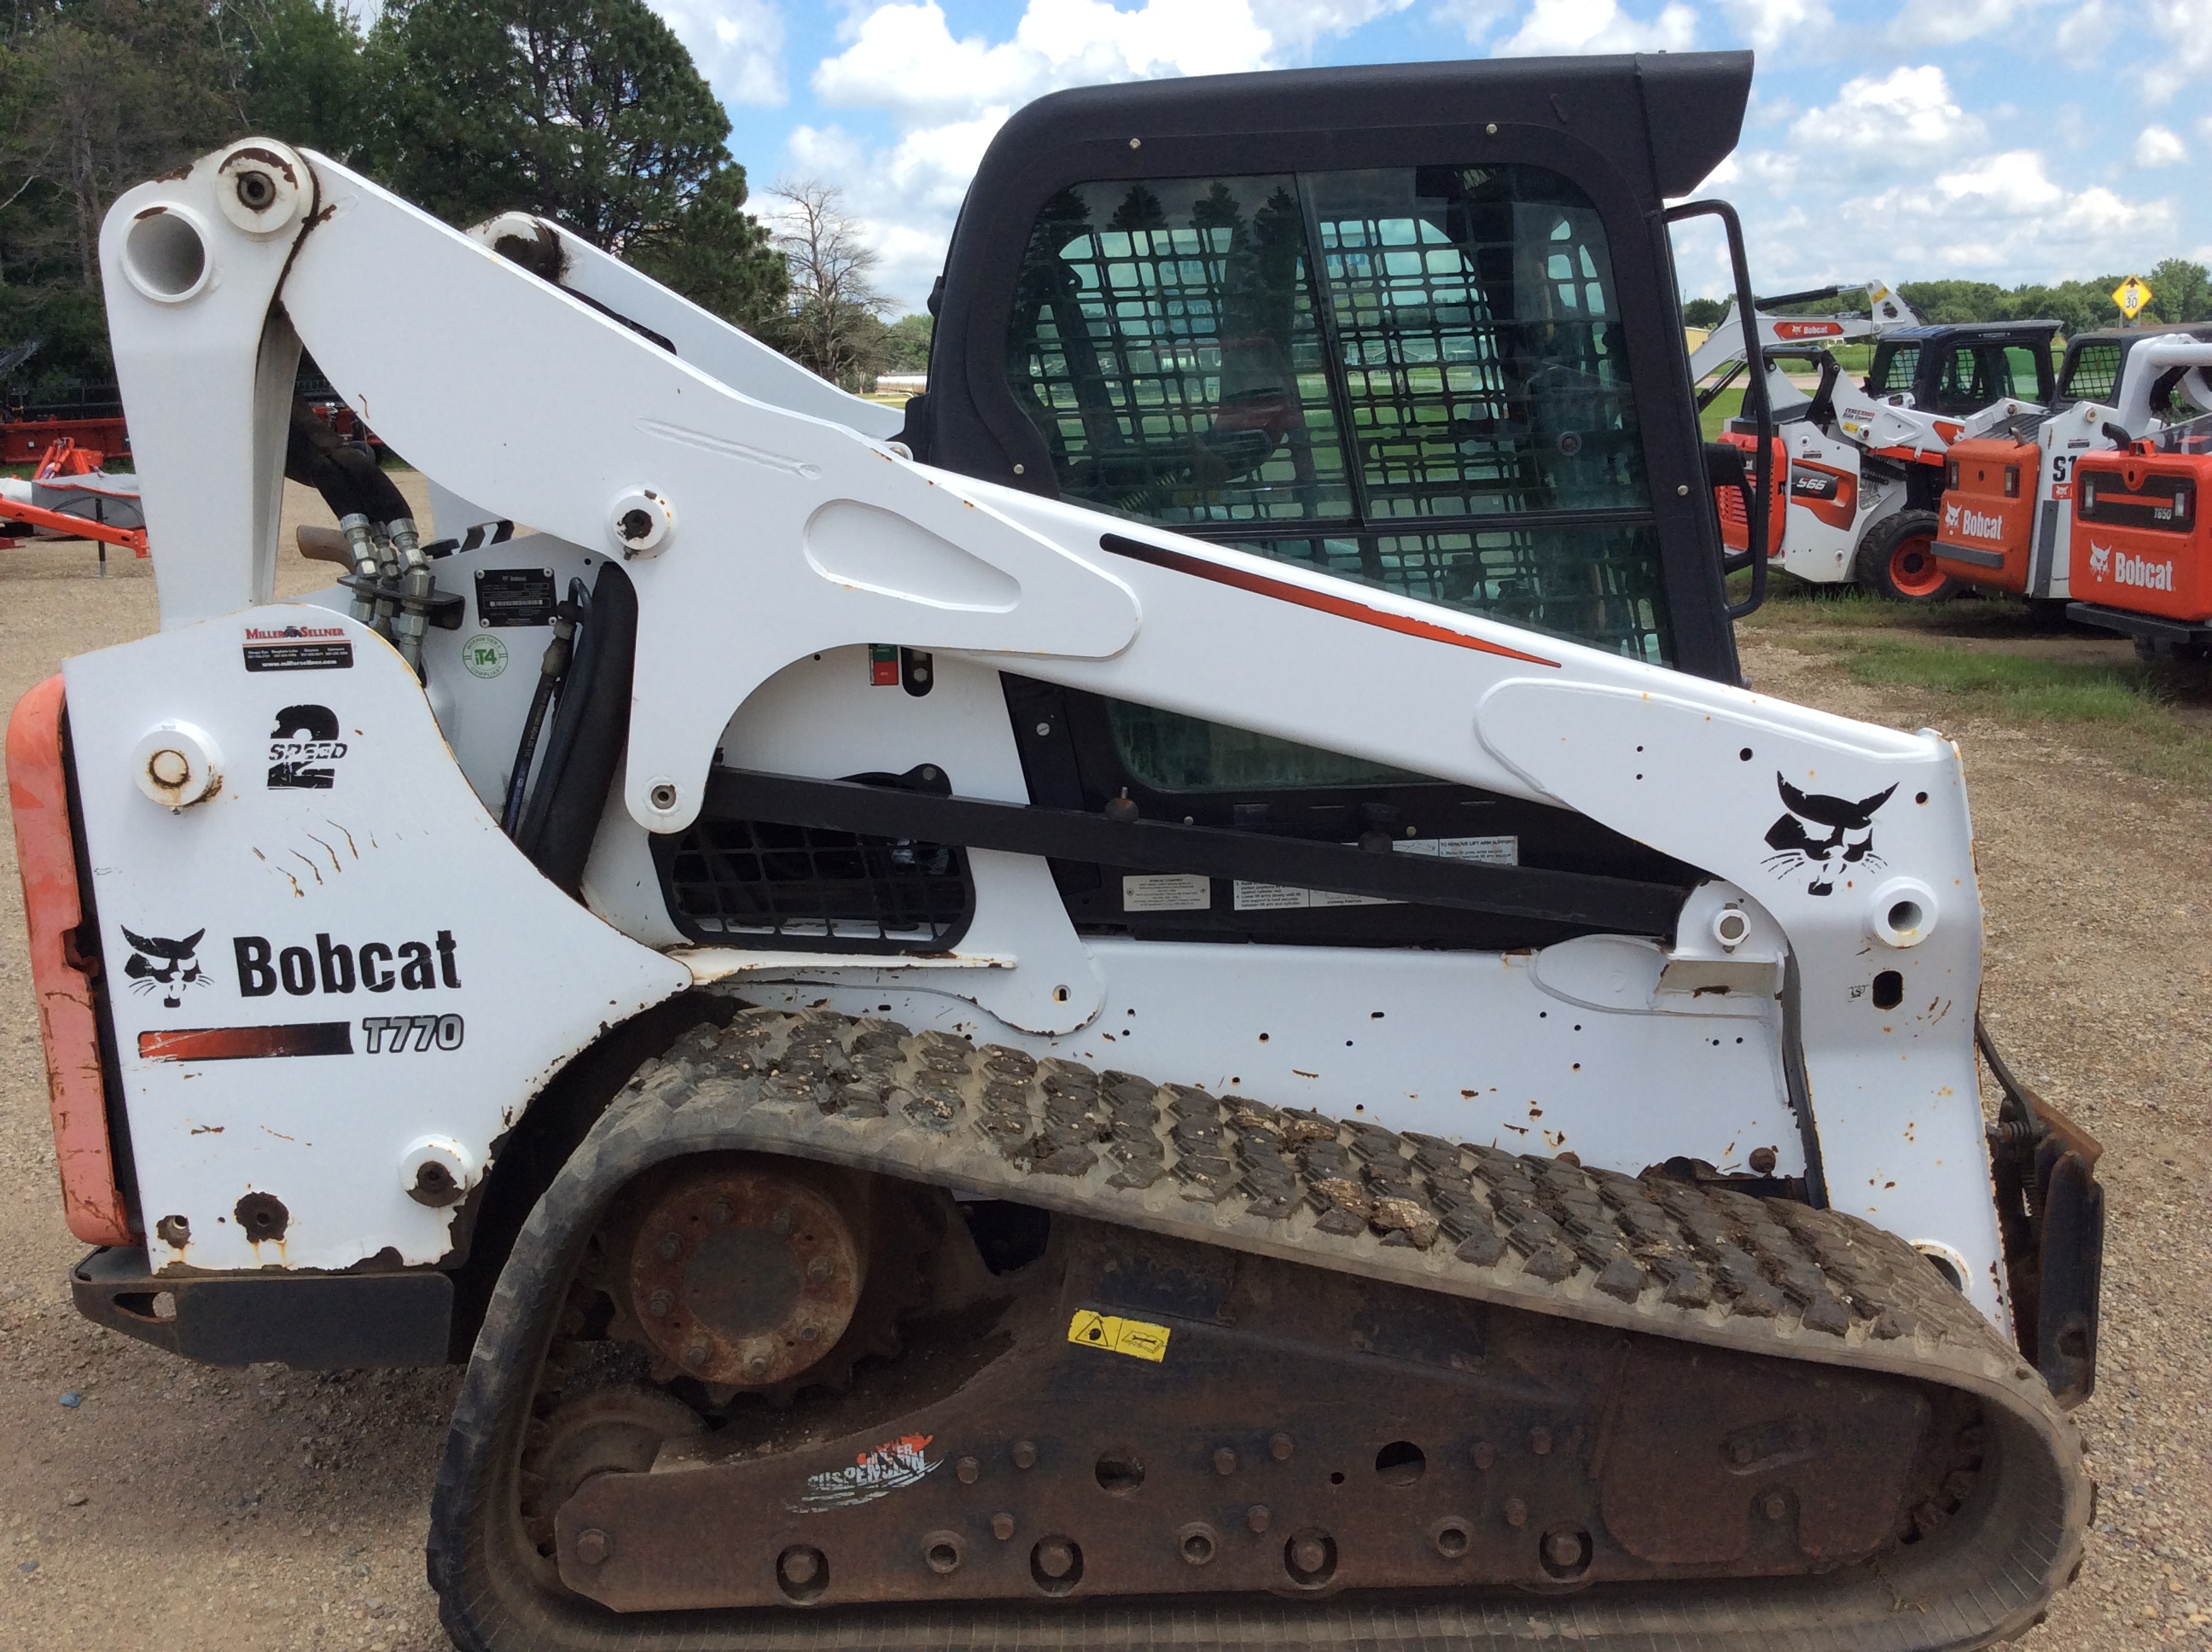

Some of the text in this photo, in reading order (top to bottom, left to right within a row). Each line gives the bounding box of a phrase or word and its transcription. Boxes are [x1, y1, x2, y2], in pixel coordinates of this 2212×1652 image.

[2126, 297, 2138, 308] 30
[1804, 326, 1828, 334] Bobcat
[1963, 509, 2002, 540] Bobcat
[2115, 552, 2173, 591] Bobcat
[245, 626, 345, 640] MILLER SELLNER
[474, 649, 498, 665] iT4
[267, 704, 340, 790] 2
[269, 743, 347, 760] SPEED
[233, 929, 462, 998] Bobcat
[363, 1013, 464, 1054] T770
